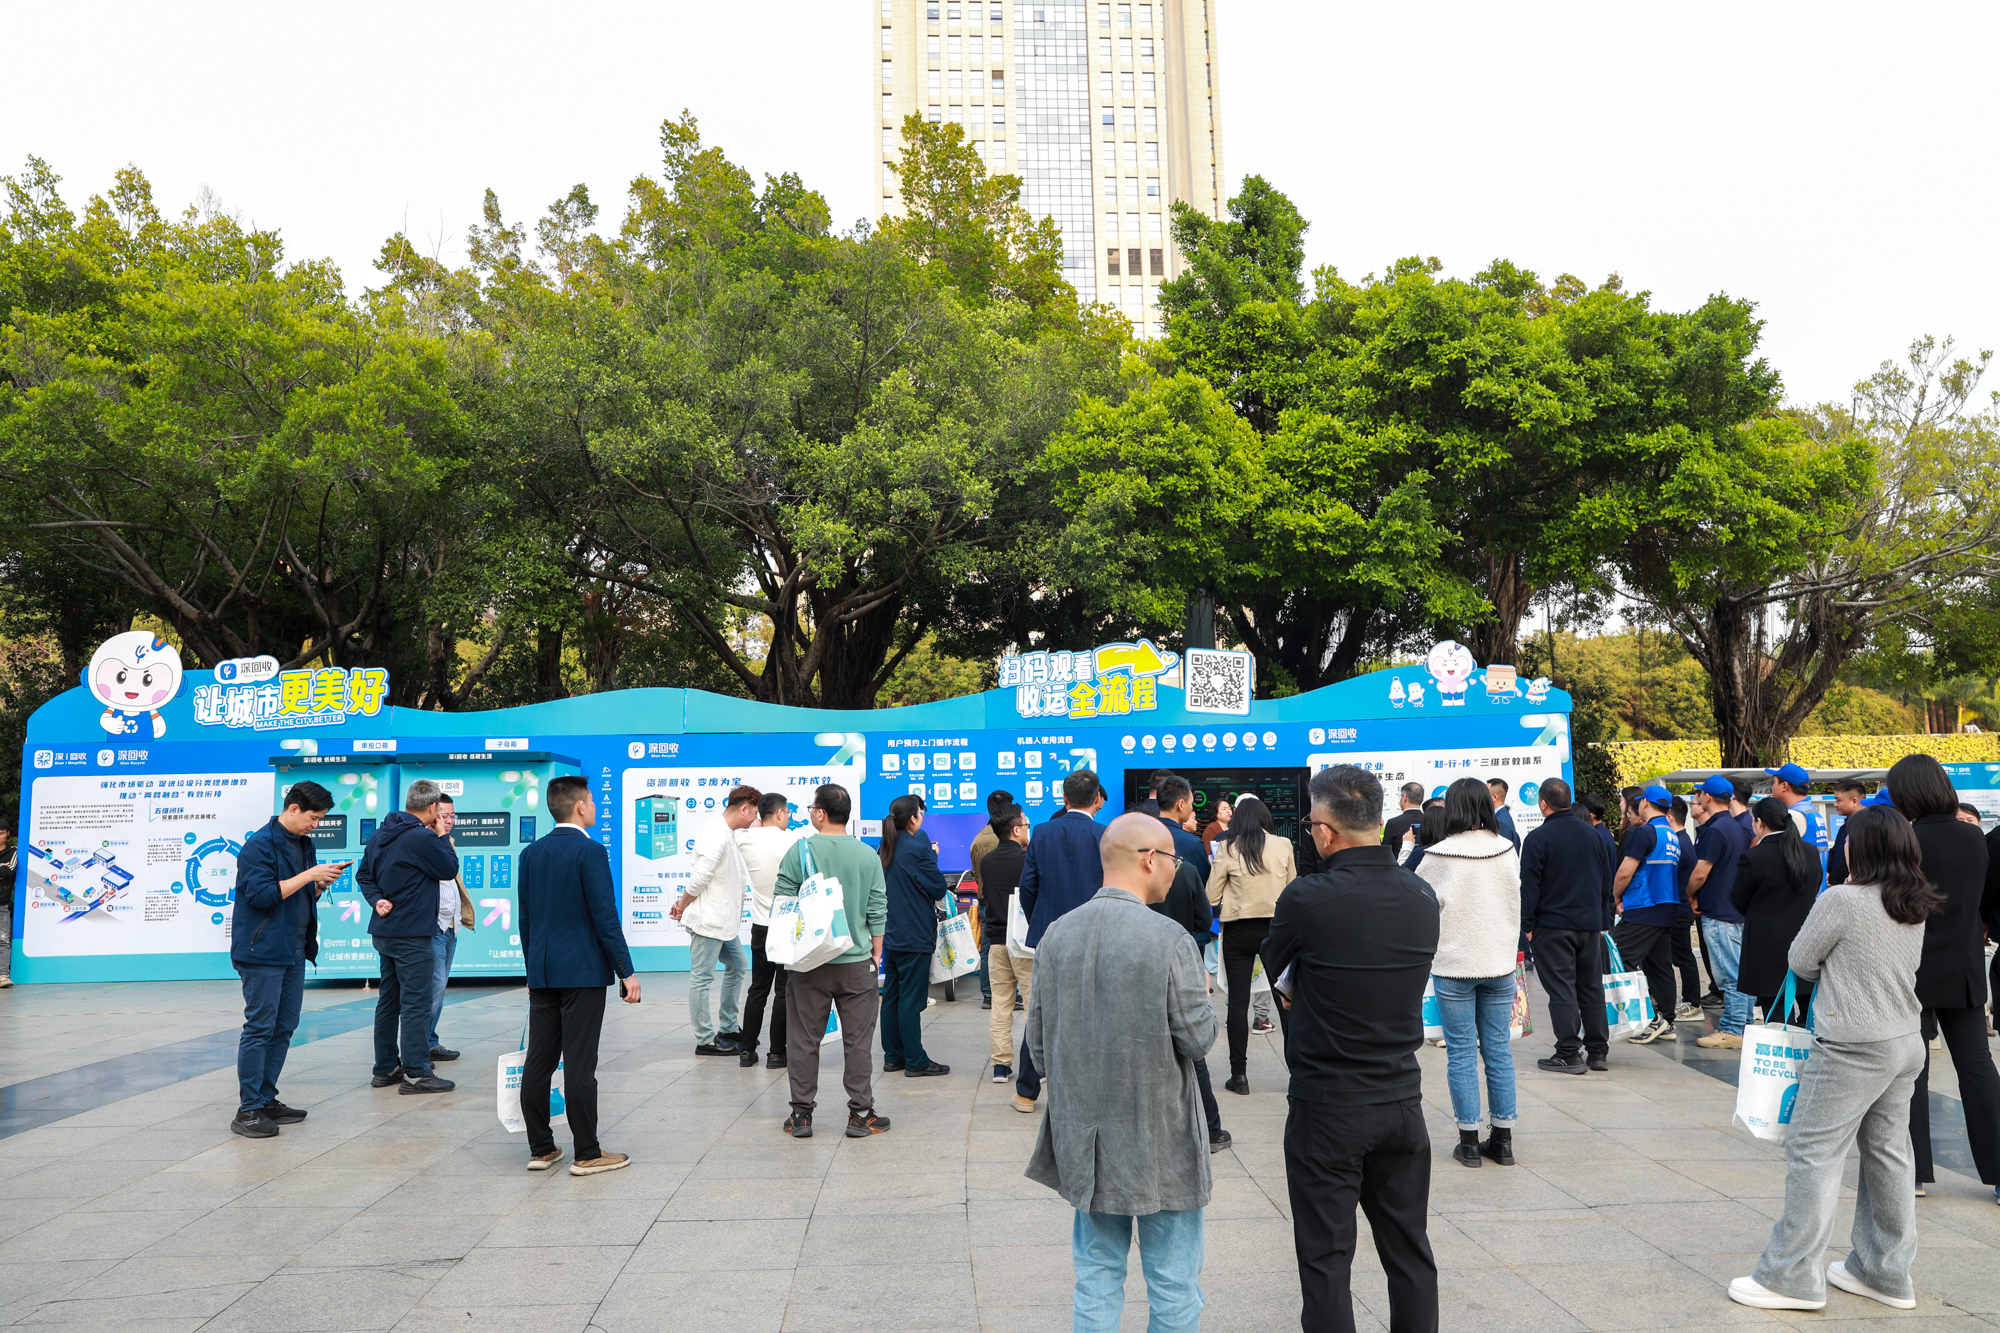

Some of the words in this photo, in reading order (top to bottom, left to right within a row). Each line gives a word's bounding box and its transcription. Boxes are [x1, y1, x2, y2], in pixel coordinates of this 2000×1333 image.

[241, 661, 272, 673] 深回收
[1002, 653, 1092, 684] 扫码观看
[195, 669, 386, 726] 让城市更美好
[1018, 675, 1155, 717] 收运全流程
[256, 720, 278, 728] MAKE
[280, 719, 294, 727] THE
[296, 718, 314, 726] CITY
[314, 715, 342, 724] BETTER
[1328, 728, 1357, 739] 深回收
[888, 738, 968, 747] 用户预约上门操作流程
[1017, 736, 1073, 745] 机器人使用流程
[648, 743, 679, 754] 深回收
[118, 750, 148, 760] 深回收
[159, 779, 247, 787] 促进垃圾分类提质增效
[647, 778, 690, 787] 资源回收
[698, 777, 742, 786] 变废为宝
[787, 776, 832, 785] 工作成效
[211, 868, 227, 876] 五维
[1754, 1058, 1771, 1066] TO
[1773, 1061, 1786, 1069] BE
